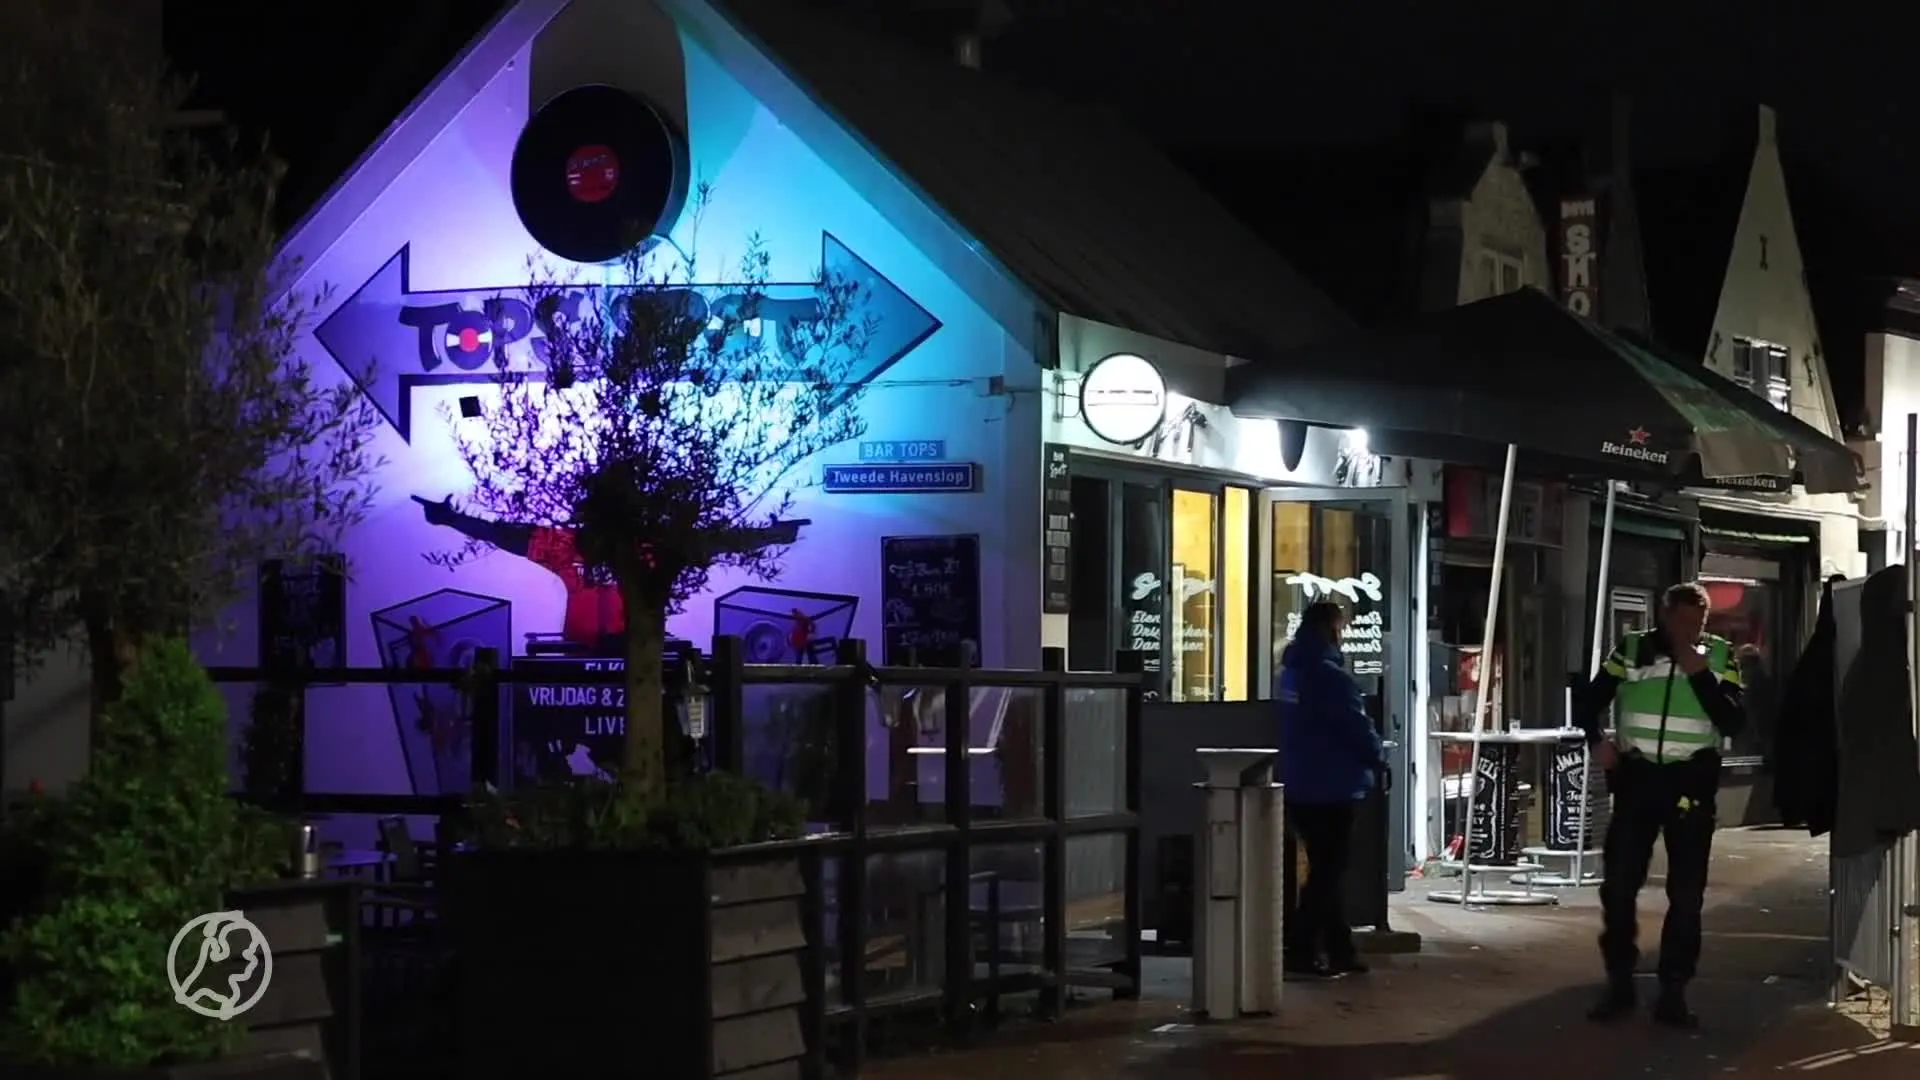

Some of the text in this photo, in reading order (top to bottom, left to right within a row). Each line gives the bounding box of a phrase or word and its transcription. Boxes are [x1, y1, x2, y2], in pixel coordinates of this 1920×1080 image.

[864, 442, 937, 458] BAR TOPS
[1601, 440, 1668, 464] Heineken
[833, 470, 964, 485] Tweede Havenslop
[528, 687, 597, 707] VRIJDAG
[600, 687, 613, 707] &
